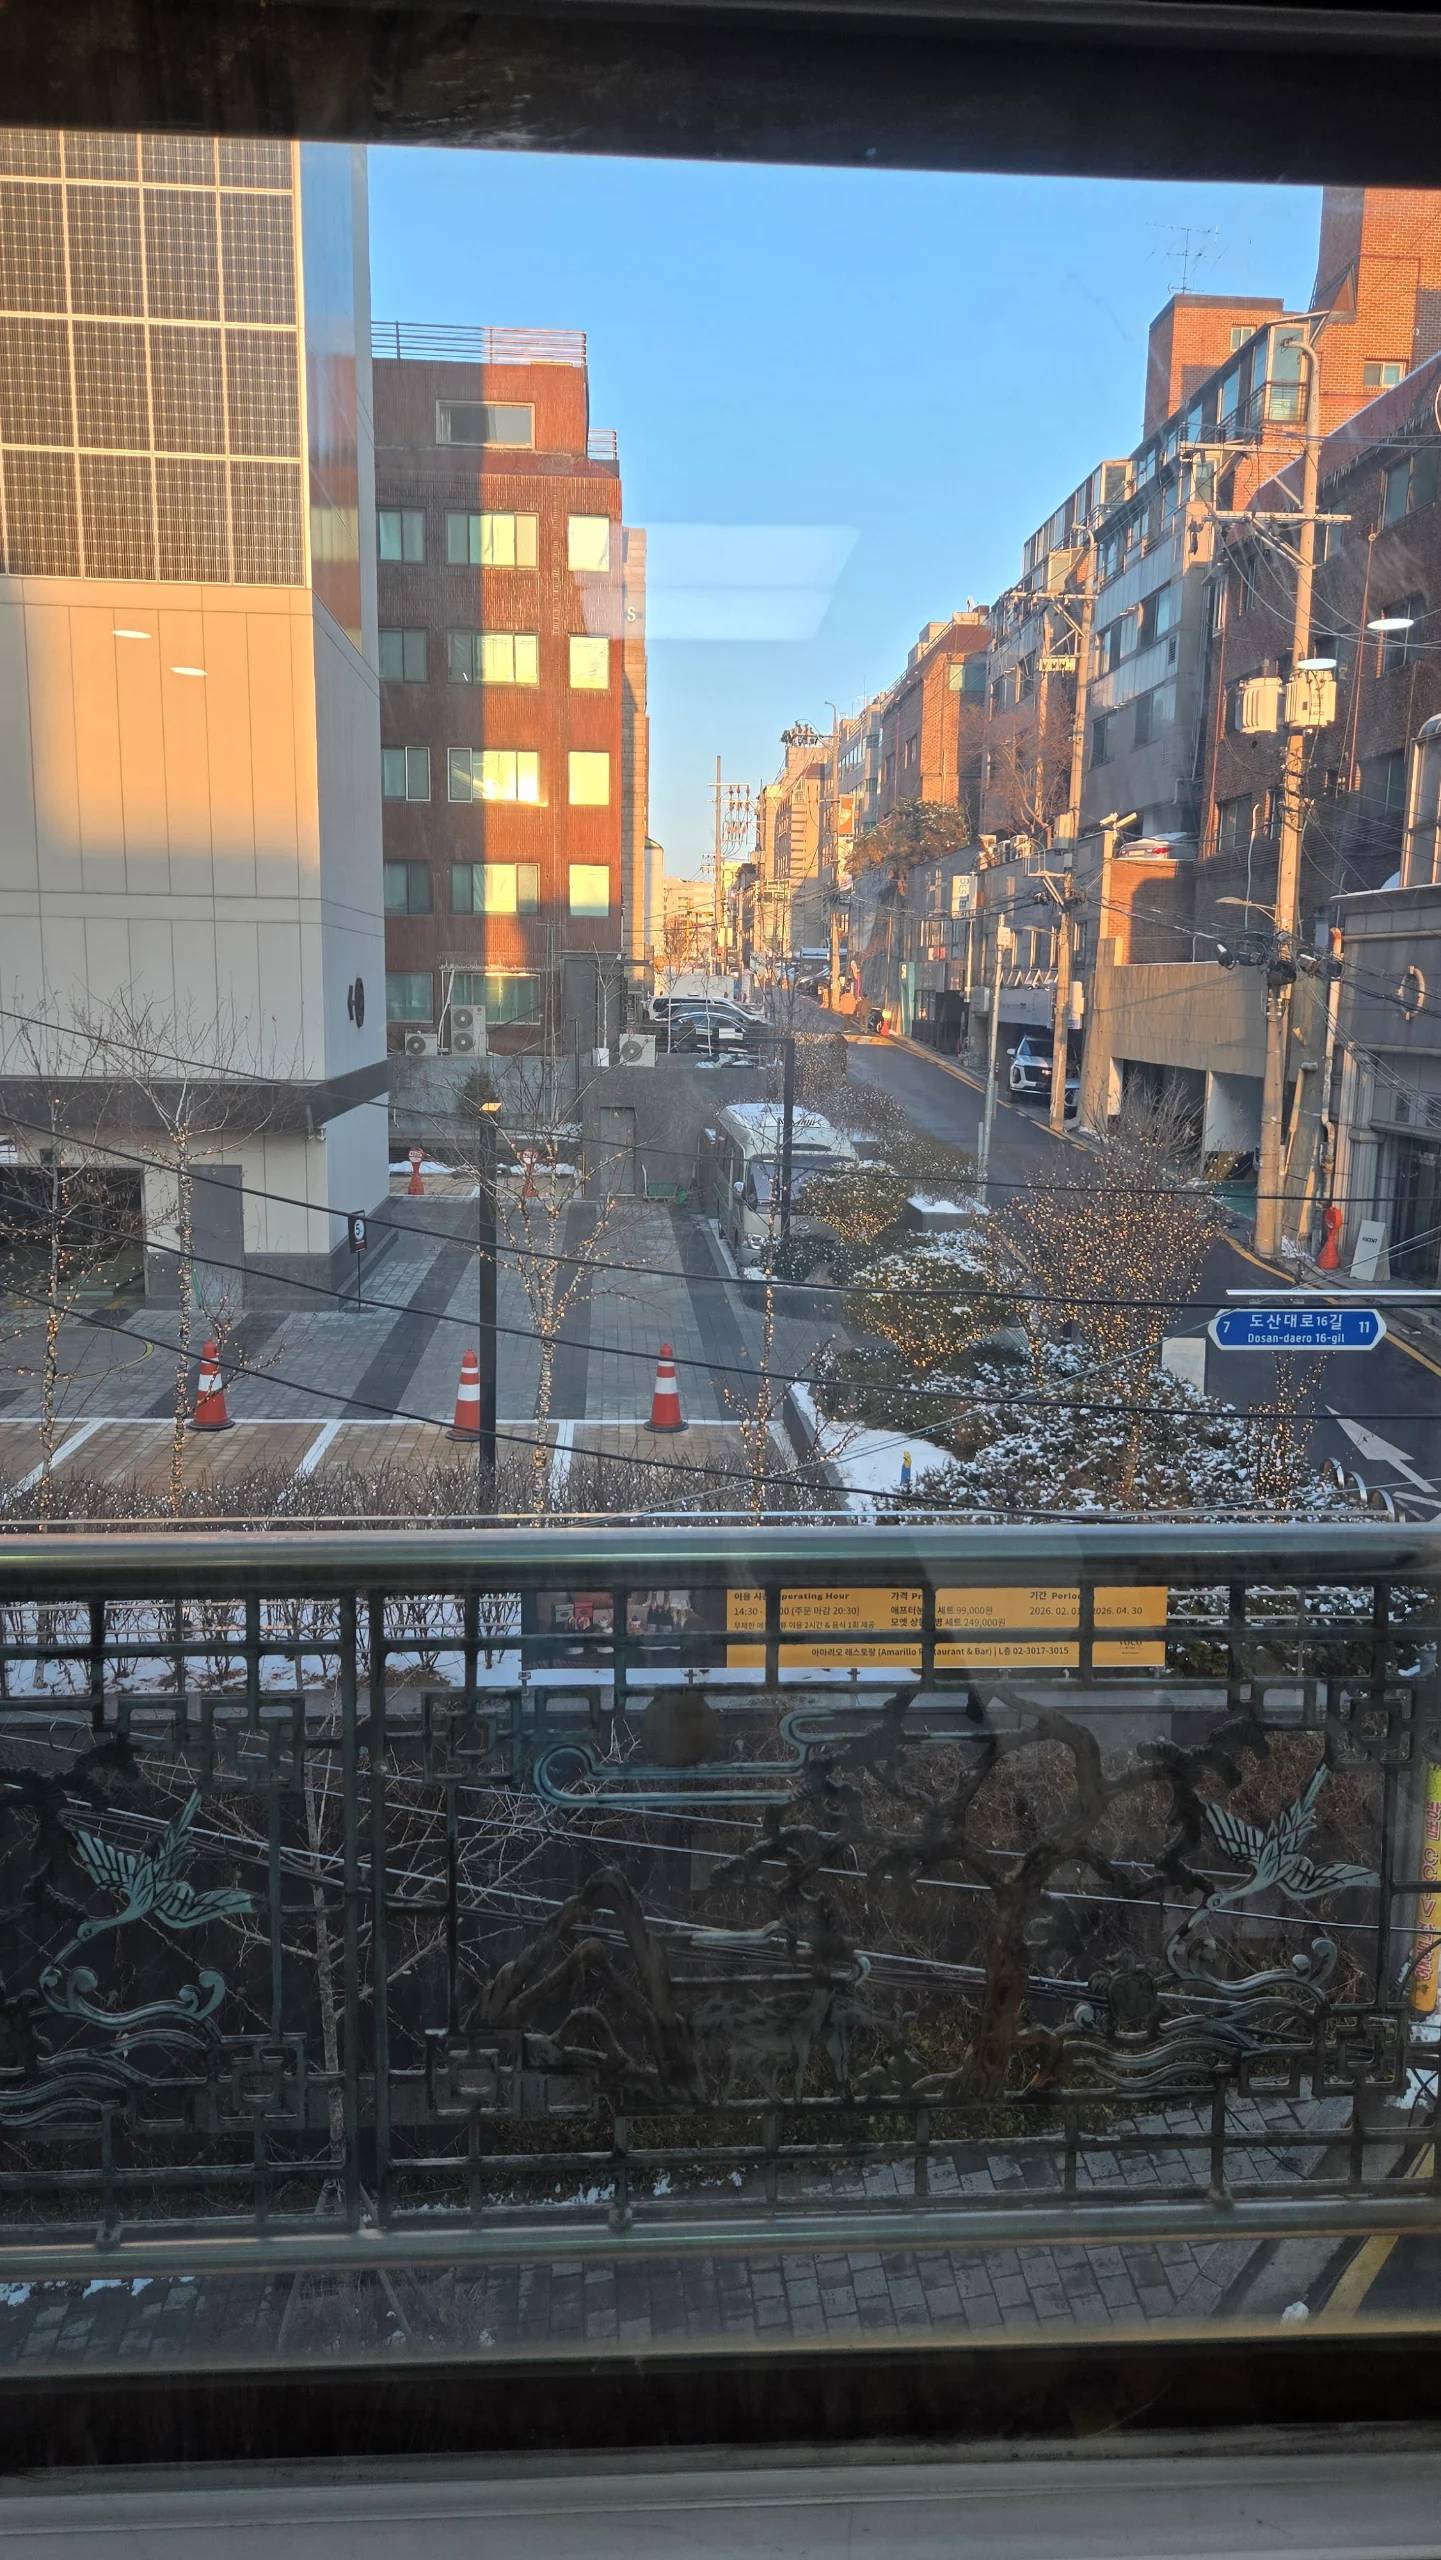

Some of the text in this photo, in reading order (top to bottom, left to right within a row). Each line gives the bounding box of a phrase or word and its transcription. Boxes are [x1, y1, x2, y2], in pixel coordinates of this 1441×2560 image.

[1223, 1321, 1230, 1333] 7
[1250, 1314, 1342, 1330] 도산대로16길
[1358, 1321, 1370, 1333] 11
[1248, 1333, 1345, 1345] Dosan-daero 16-gil
[781, 1593, 823, 1601] perating
[826, 1592, 849, 1600] Hour
[890, 1592, 908, 1600] 가격
[1030, 1591, 1047, 1600] 기간
[734, 1607, 758, 1616] 14:30
[833, 1606, 860, 1617] 20:30)
[1030, 1607, 1053, 1616] 2026.
[1055, 1607, 1069, 1616] 02.
[1116, 1606, 1129, 1615] 04.
[1132, 1606, 1143, 1615] 30
[811, 1647, 843, 1657] 아마리오
[844, 1647, 876, 1657] 레스토랑
[878, 1647, 917, 1657] (Amarillo
[966, 1647, 973, 1655] &
[974, 1647, 992, 1657] Bar)
[1013, 1646, 1069, 1655] 02-3017-3015
